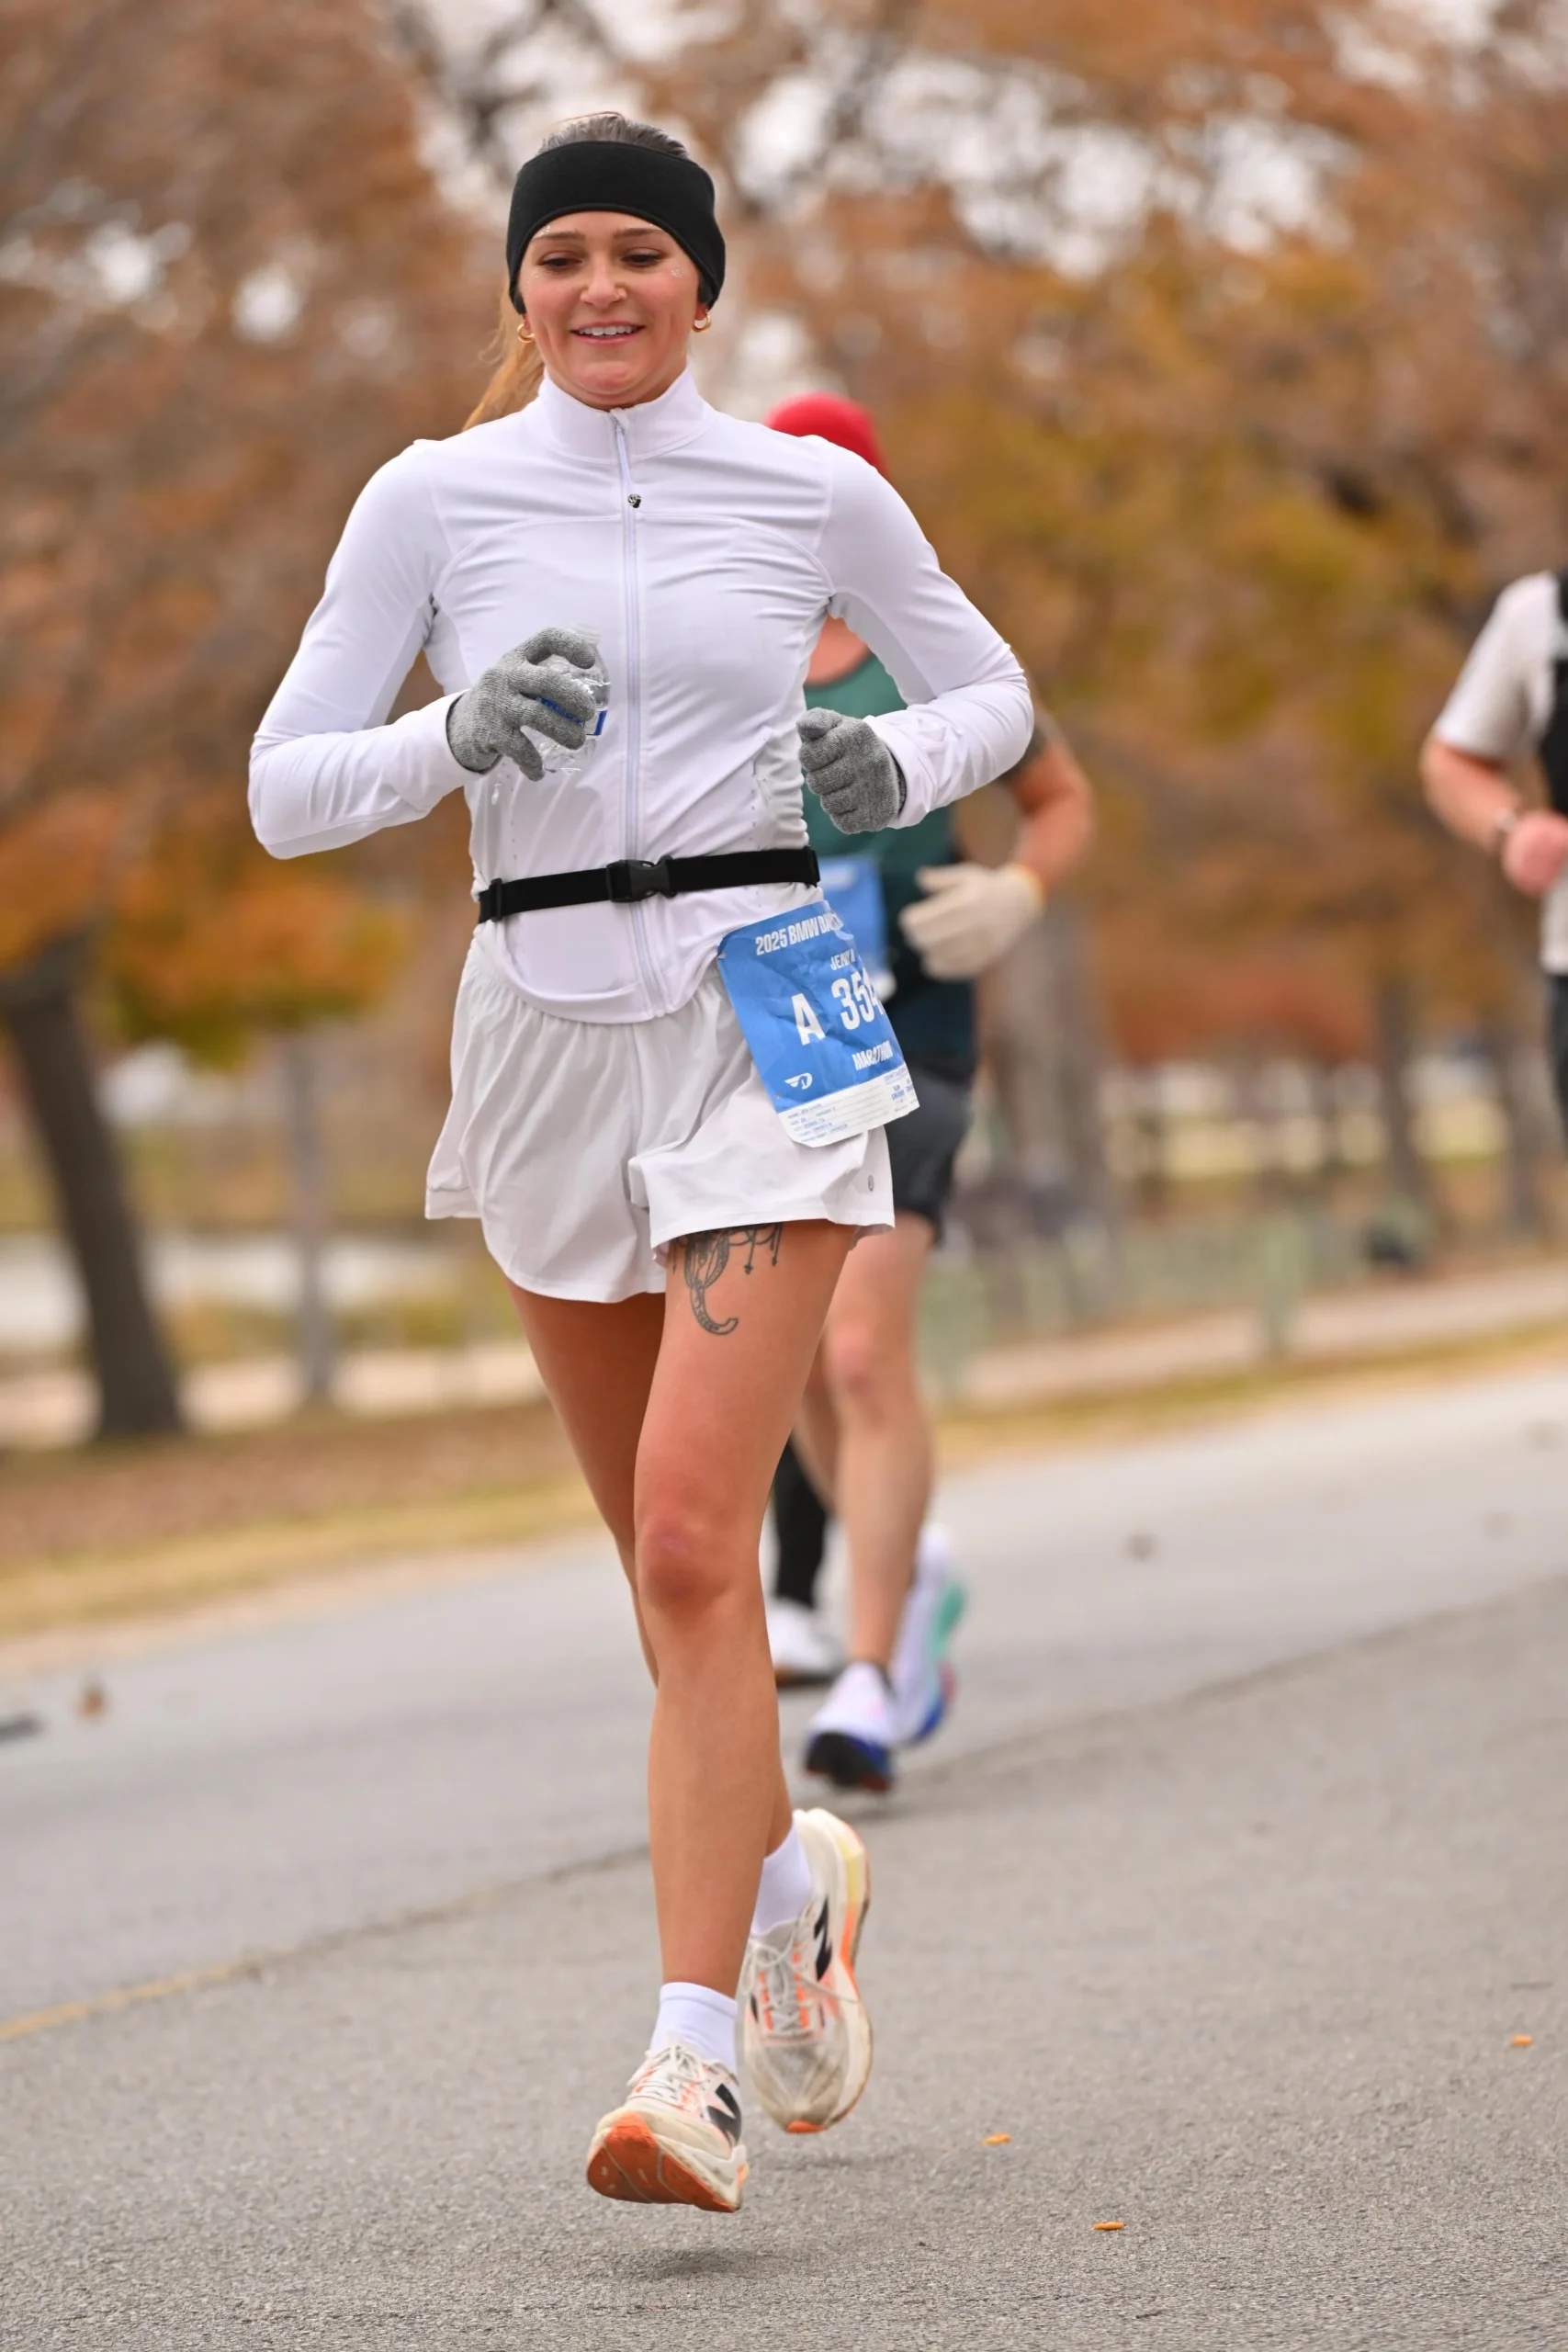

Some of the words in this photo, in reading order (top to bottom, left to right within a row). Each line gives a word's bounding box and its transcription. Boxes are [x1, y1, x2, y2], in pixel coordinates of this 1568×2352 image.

[756, 928, 788, 956] 2025
[788, 917, 820, 944] BMW
[791, 993, 827, 1046] A
